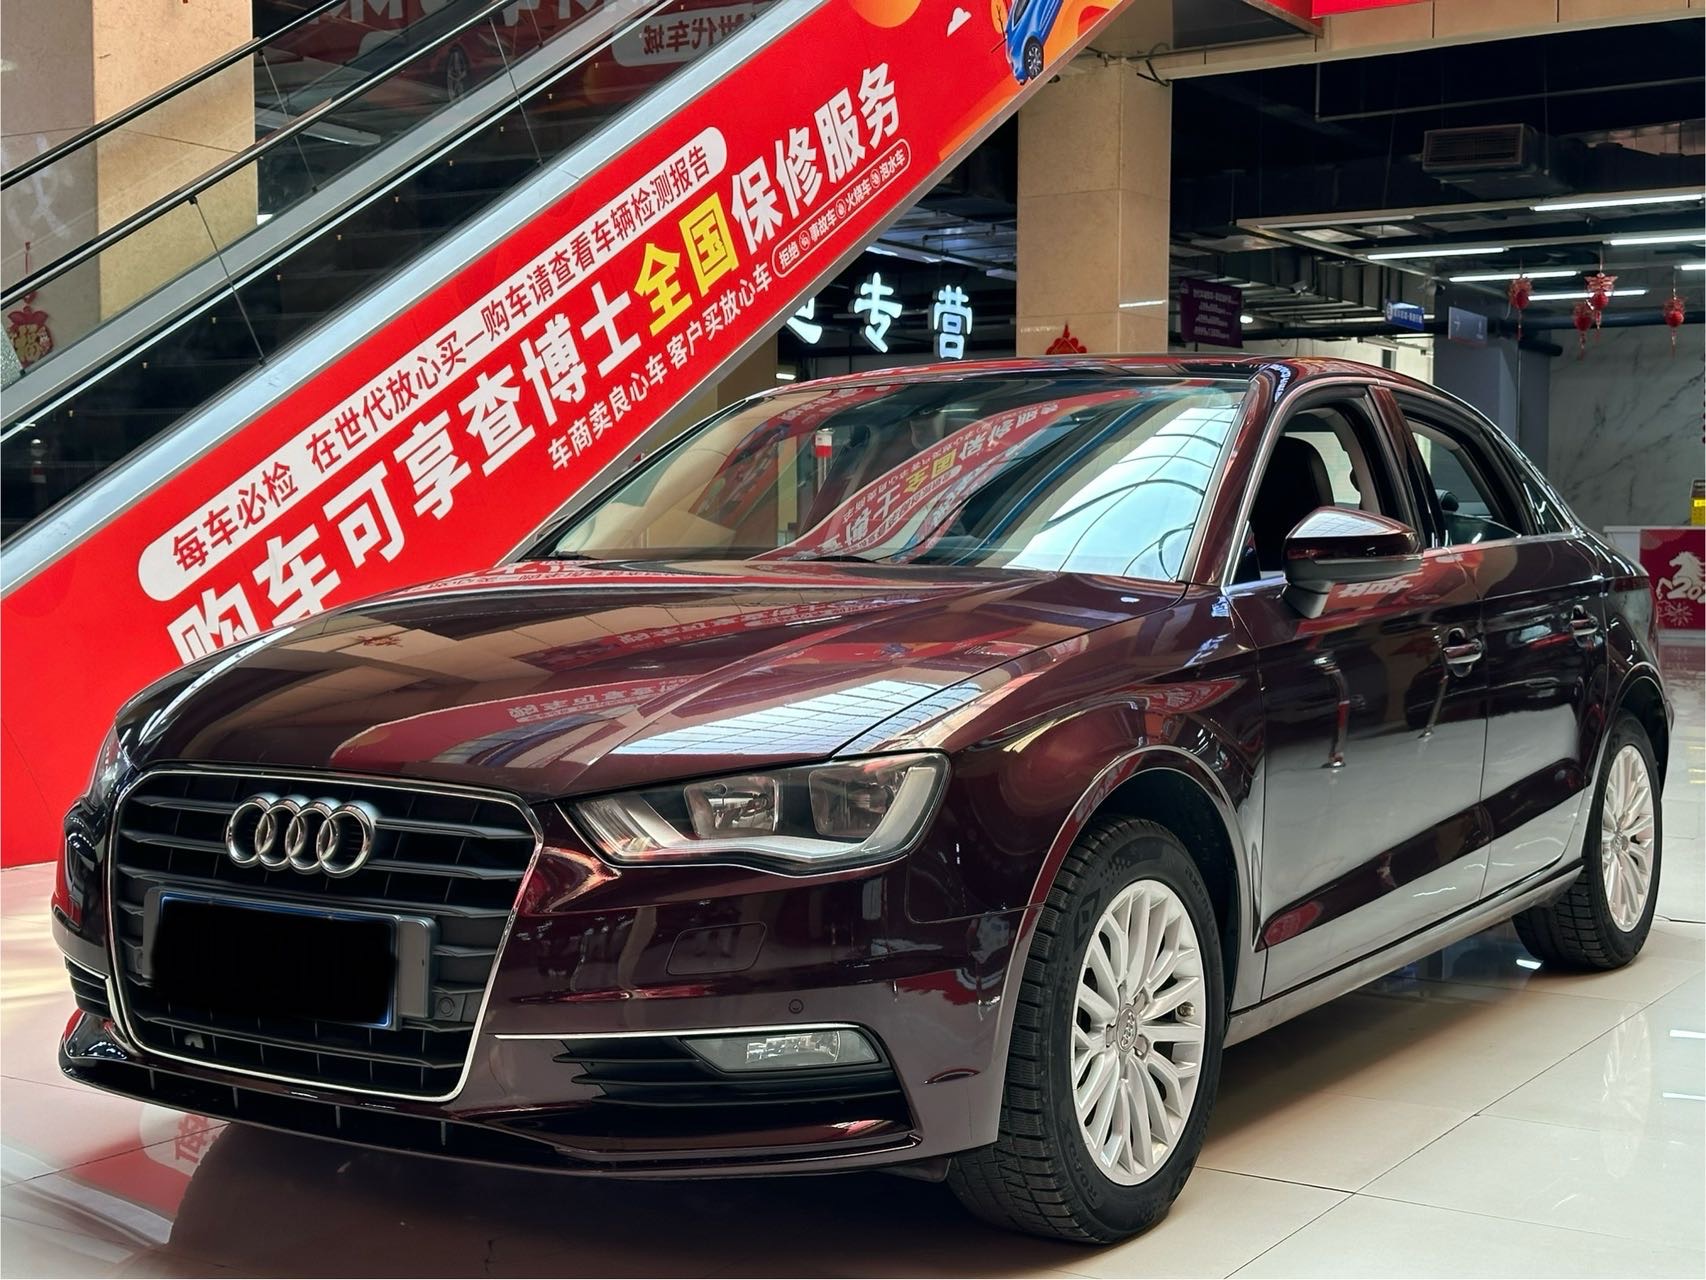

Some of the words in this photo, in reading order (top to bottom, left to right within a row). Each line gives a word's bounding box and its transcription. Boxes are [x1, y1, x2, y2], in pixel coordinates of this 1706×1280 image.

[778, 241, 801, 270] 拒绝
[808, 208, 837, 242] 事故车
[845, 178, 872, 211] 火烧车
[879, 149, 906, 182] 泡水车
[547, 353, 668, 471] 车商卖良心车
[666, 263, 773, 370] 客户买放心车
[173, 461, 298, 571] 每车必检
